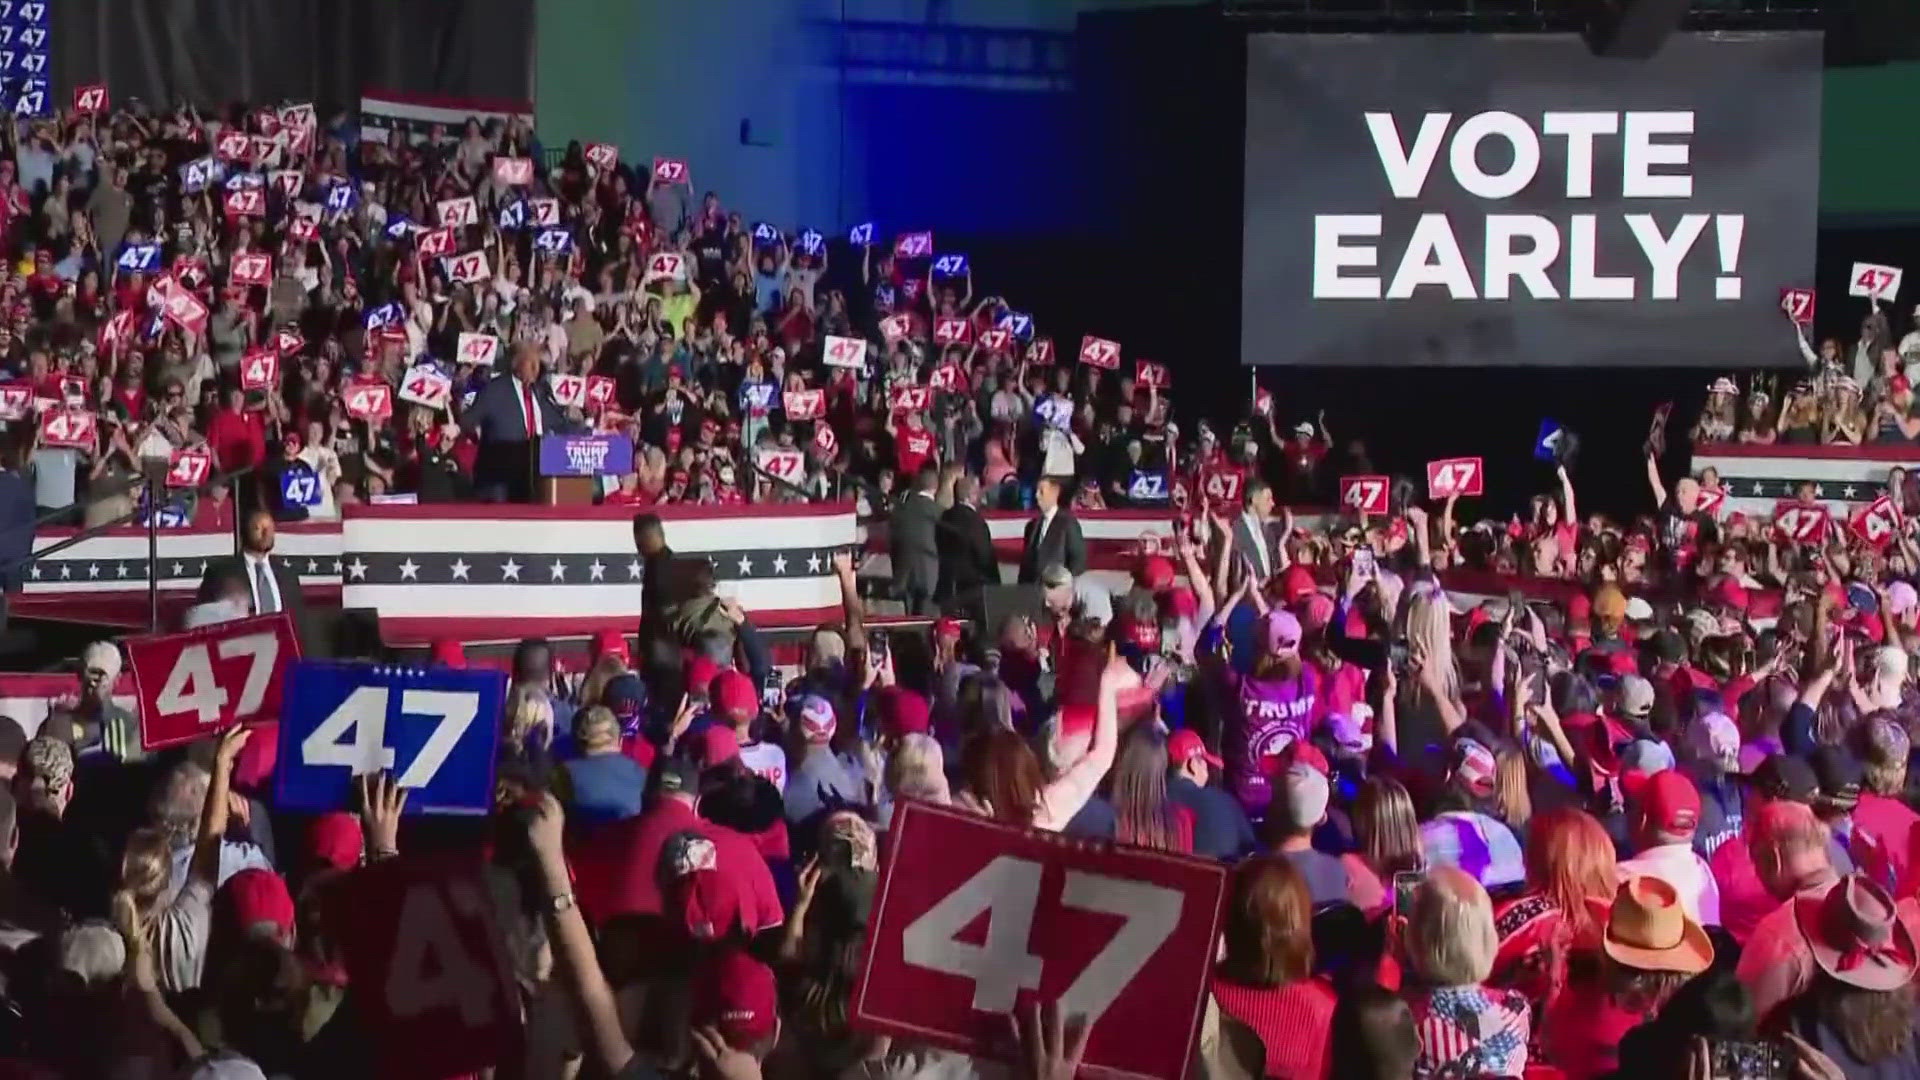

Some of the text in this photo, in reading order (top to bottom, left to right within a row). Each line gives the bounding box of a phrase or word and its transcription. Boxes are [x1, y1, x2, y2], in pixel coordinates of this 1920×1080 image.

[0, 1, 13, 18] 7
[19, 3, 45, 20] 47
[0, 26, 13, 43] 7
[20, 28, 46, 46] 47
[21, 54, 46, 72] 47
[16, 91, 44, 115] 47
[78, 89, 104, 109] 47
[220, 136, 248, 158] 47
[587, 146, 616, 163] 47
[1364, 110, 1695, 198] VOTE
[188, 158, 214, 184] 47
[657, 163, 682, 179] 47
[228, 192, 259, 211] 47
[328, 186, 350, 208] 47
[444, 202, 471, 226] 47
[501, 200, 524, 228] 47
[421, 229, 447, 250] 47
[537, 231, 569, 250] 47
[756, 223, 777, 240] 47
[851, 223, 873, 244] 47
[900, 235, 929, 254] 47
[119, 246, 154, 268] 47
[653, 256, 679, 274] 47
[936, 256, 963, 273] 47
[1313, 212, 1745, 300] EARLY!
[234, 259, 267, 279] 47
[453, 257, 478, 279] 47
[1858, 269, 1895, 294] 47
[1782, 291, 1809, 316] 47
[368, 304, 393, 328] 47
[1000, 315, 1028, 334] 47
[937, 321, 966, 339] 47
[979, 331, 1006, 348] 47
[465, 340, 493, 359] 47
[830, 341, 861, 361] 47
[1027, 342, 1049, 361] 47
[1084, 342, 1116, 363] 47
[247, 357, 275, 384] 47
[929, 365, 955, 387] 47
[1140, 364, 1165, 384] 47
[408, 378, 443, 399] 47
[556, 380, 581, 400] 47
[590, 380, 613, 401] 47
[897, 388, 926, 408] 47
[351, 389, 385, 413] 47
[790, 395, 820, 415] 47
[47, 415, 90, 441] 47
[566, 446, 609, 457] TRUMP
[172, 456, 207, 481] 47
[767, 457, 798, 476] 47
[1434, 463, 1475, 490] 47
[286, 478, 315, 502] 47
[1134, 476, 1162, 496] 47
[1207, 474, 1237, 498] 47
[1344, 482, 1382, 509] 47
[1779, 507, 1823, 539] 47
[1866, 499, 1903, 541] 47
[156, 631, 279, 724] 47
[1245, 695, 1315, 719] TRUMP
[302, 686, 480, 788] 47
[903, 855, 1185, 1027] 47
